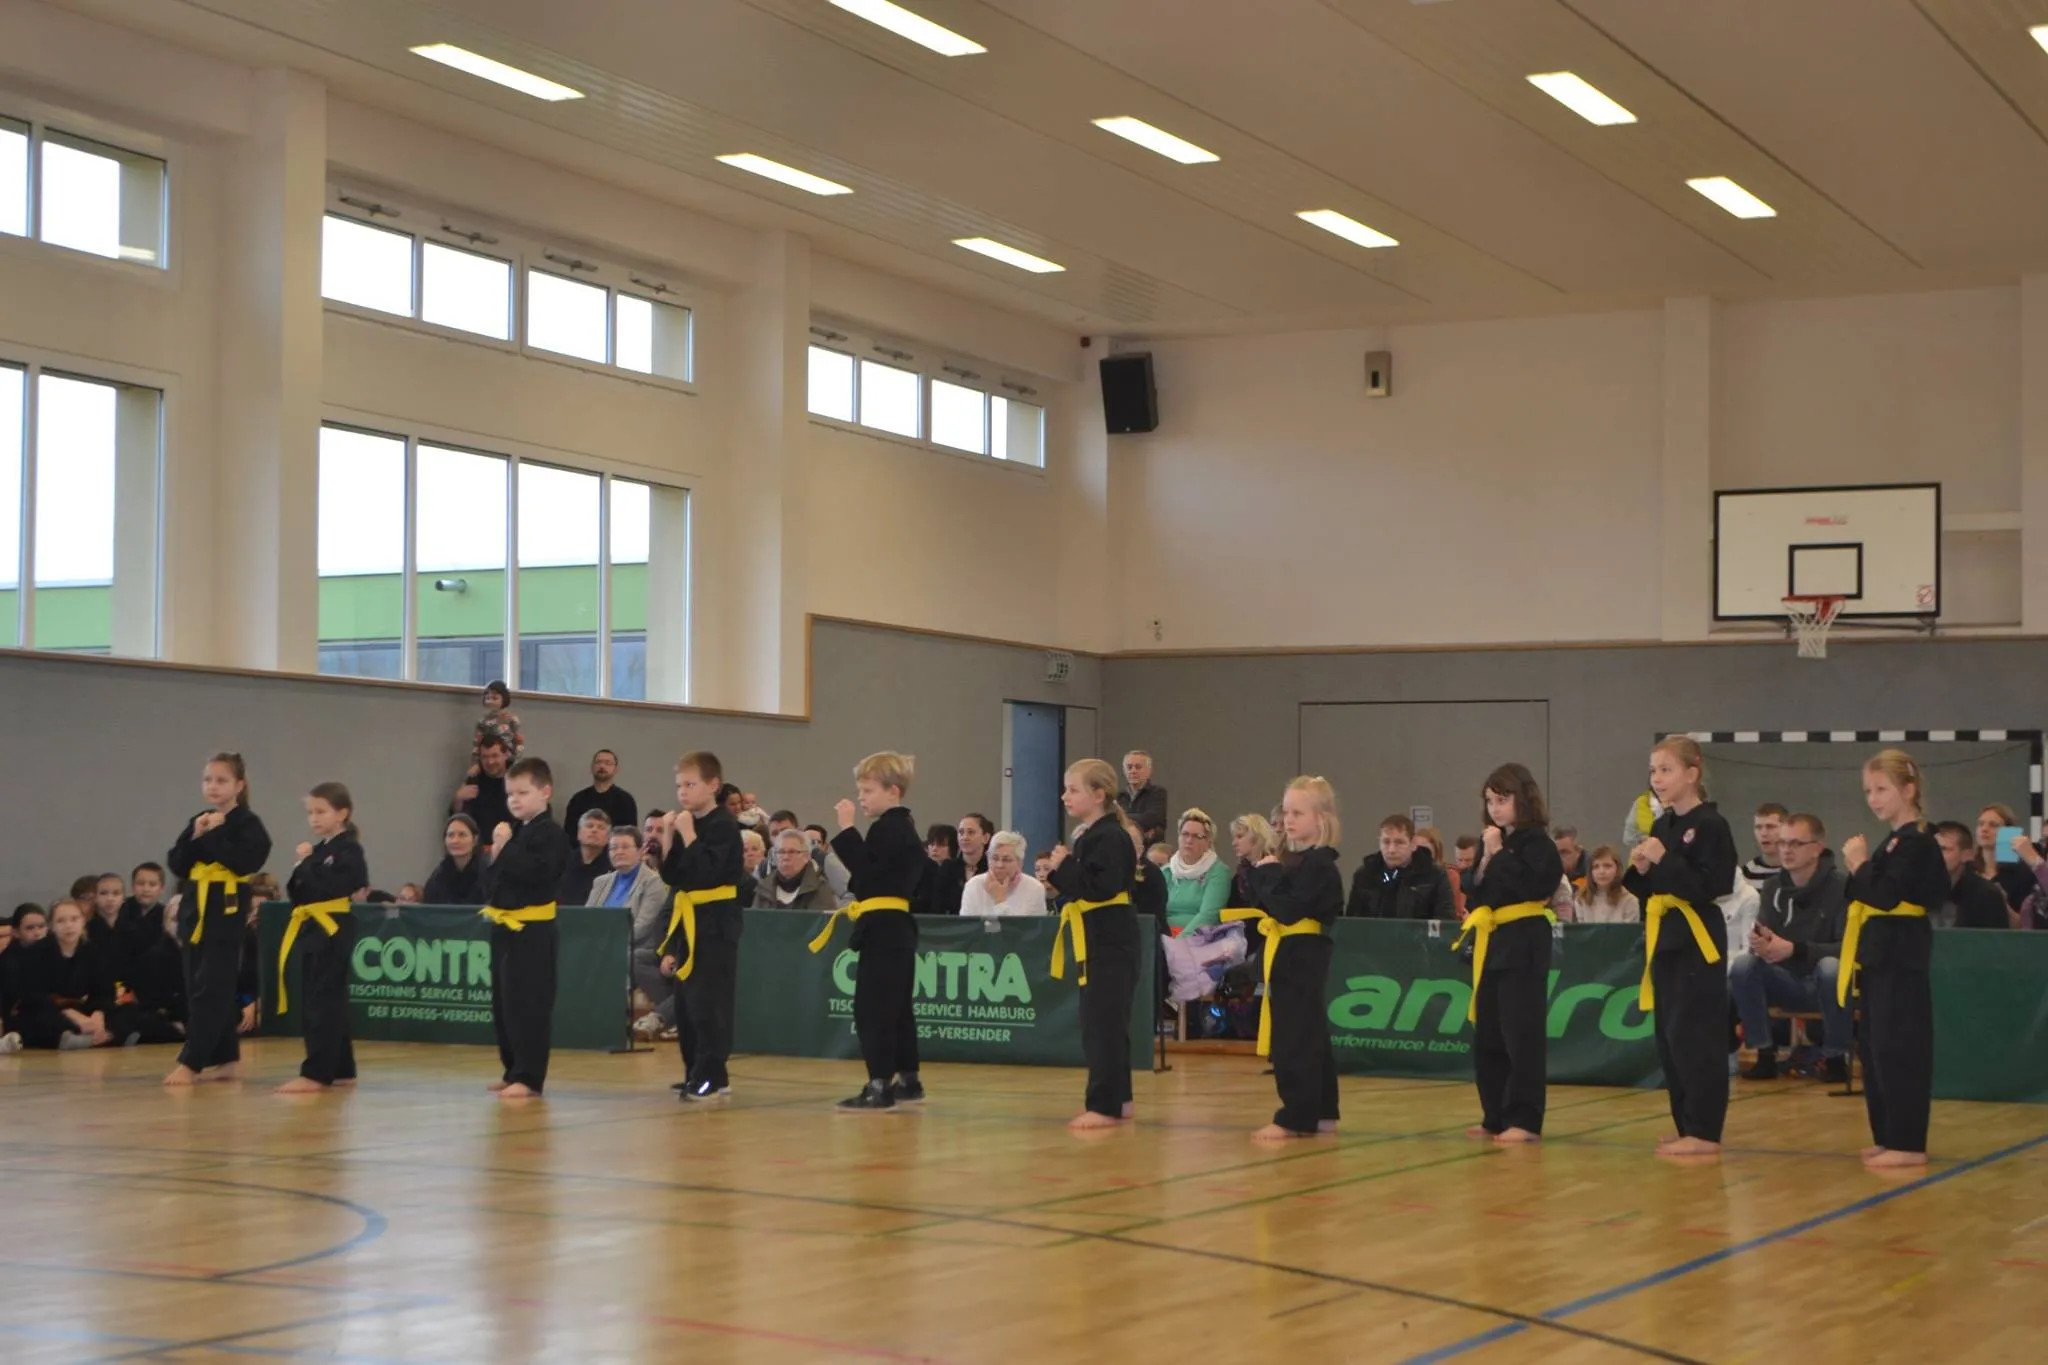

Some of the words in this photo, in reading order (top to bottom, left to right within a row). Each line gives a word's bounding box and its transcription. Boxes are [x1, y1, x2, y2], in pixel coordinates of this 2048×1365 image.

[352, 936, 492, 986] CONTR
[832, 948, 1032, 1004] CNTRA
[420, 987, 464, 1001] SERVICE
[368, 1005, 389, 1018] DER
[391, 1006, 493, 1023] EXPRESS-VERSEND
[912, 1003, 963, 1018] SERVICE
[967, 1005, 1036, 1021] HAMBURG
[1327, 969, 1655, 1041] anro
[917, 1025, 1011, 1042] SS-VERSENDER
[1330, 1034, 1424, 1051] erformance
[1428, 1039, 1471, 1054] table
